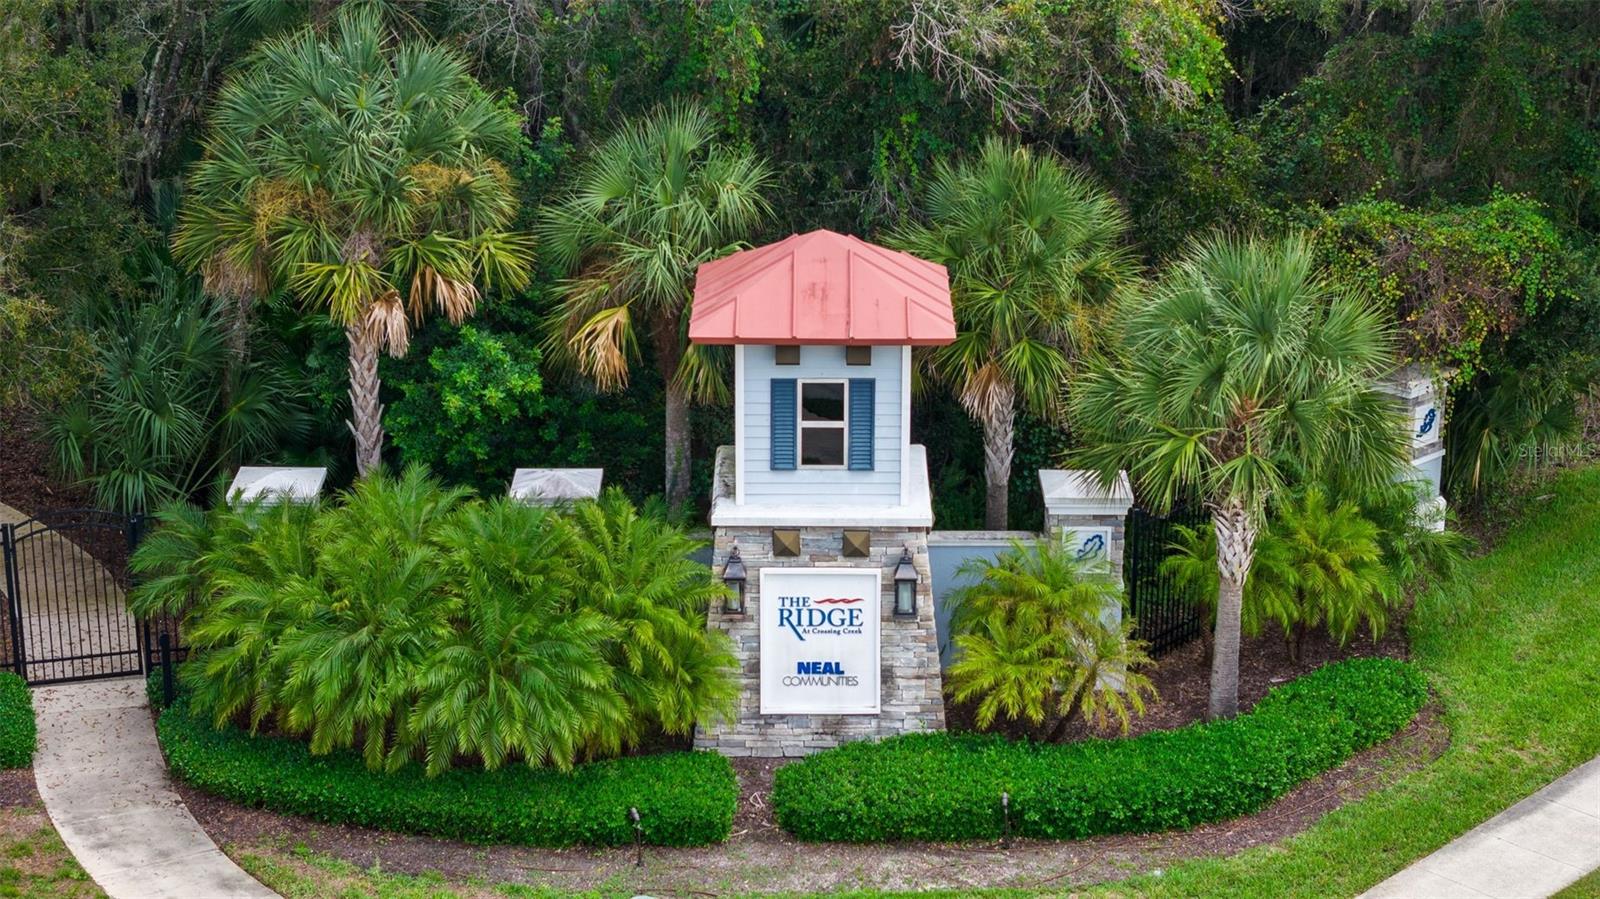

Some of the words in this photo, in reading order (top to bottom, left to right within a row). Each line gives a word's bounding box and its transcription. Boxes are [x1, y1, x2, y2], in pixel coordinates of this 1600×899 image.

[778, 596, 811, 607] THE
[777, 608, 864, 641] RIDGE
[812, 627, 841, 635] Crossing
[797, 661, 845, 675] NEAL
[782, 676, 859, 687] COMMUNITIES
